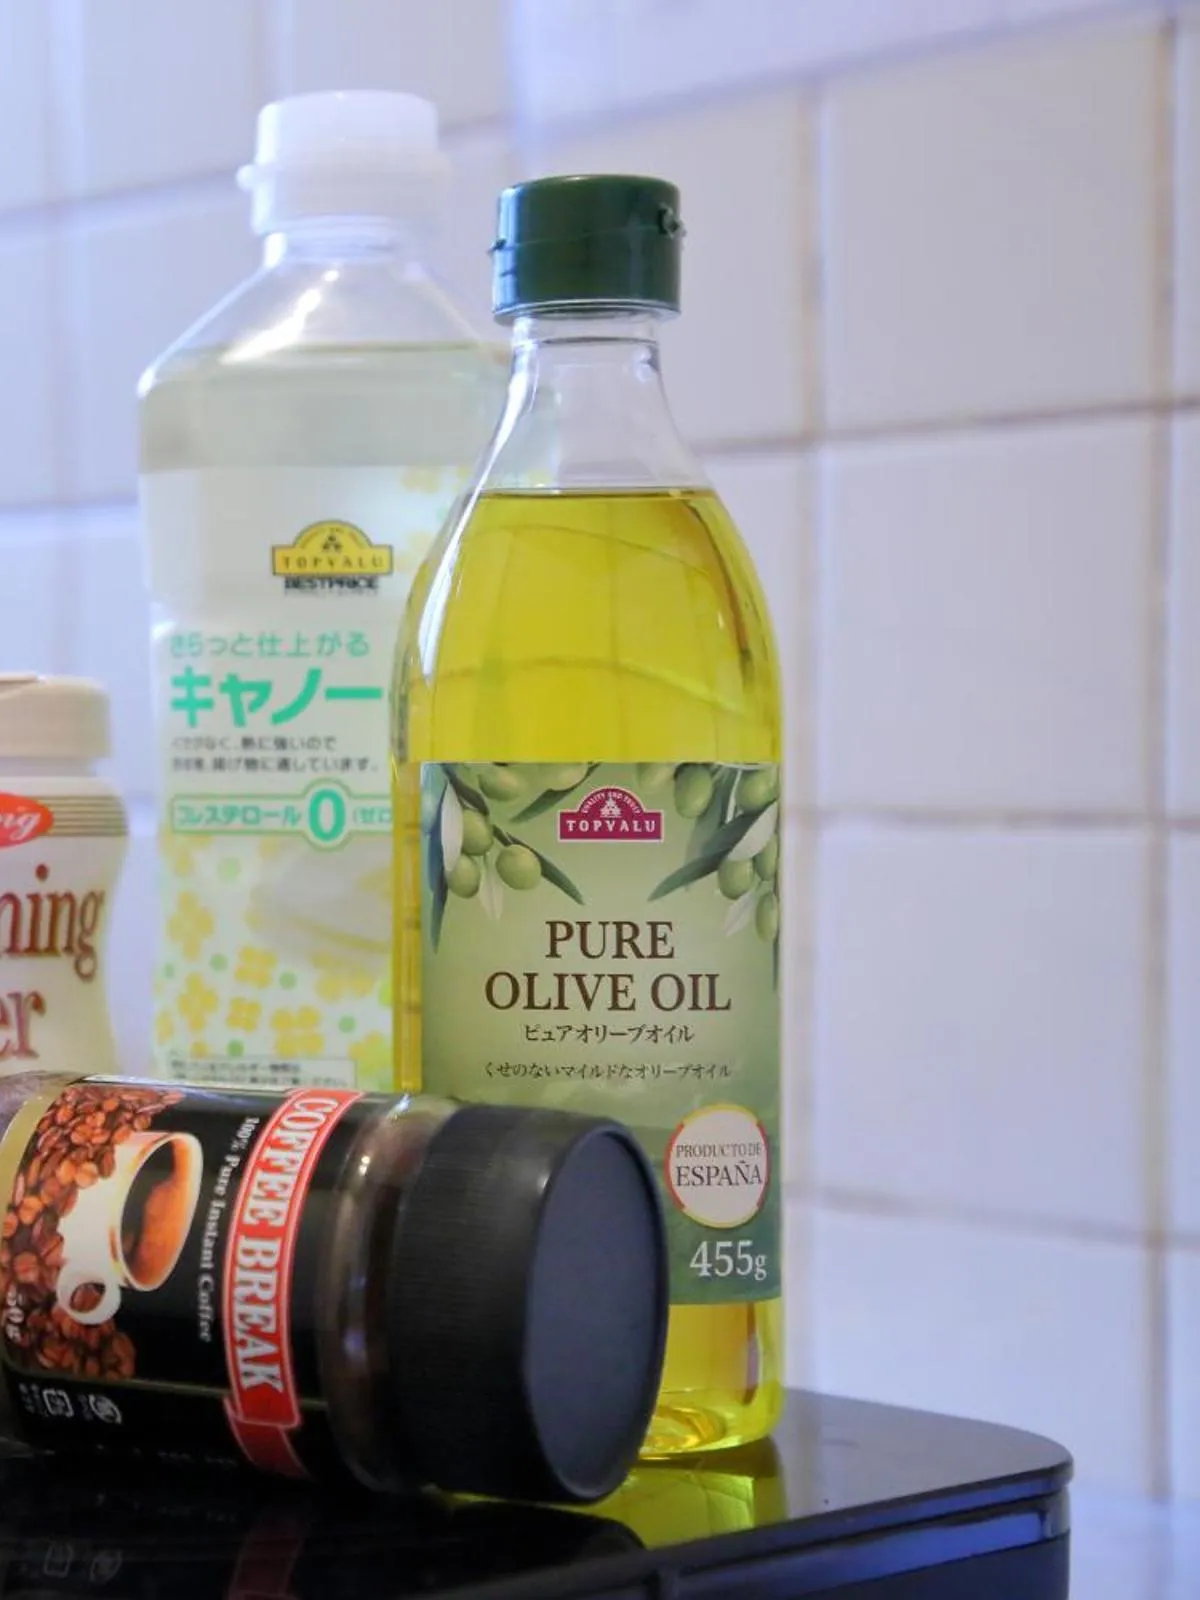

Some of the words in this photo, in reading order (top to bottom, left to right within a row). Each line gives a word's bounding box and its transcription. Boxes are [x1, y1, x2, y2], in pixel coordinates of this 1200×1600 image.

[177, 805, 302, 826] コレステロール
[566, 819, 656, 833] TOPVALU
[545, 920, 675, 959] PURE
[484, 971, 636, 1011] OLIVE
[650, 973, 732, 1011] OIL
[525, 1023, 695, 1044] ピュアオリーブオイル
[484, 1061, 731, 1080] くせのないマイルドなオリーブオイル
[243, 1098, 339, 1227] COFFEE
[675, 1142, 746, 1159] PRODUCTO
[214, 1155, 241, 1196] Pure
[675, 1160, 763, 1187] ESPAÑA
[199, 1200, 227, 1269] Instant
[689, 1240, 768, 1281] 455g
[198, 1272, 216, 1343] Coffee
[234, 1235, 285, 1393] BREAK
